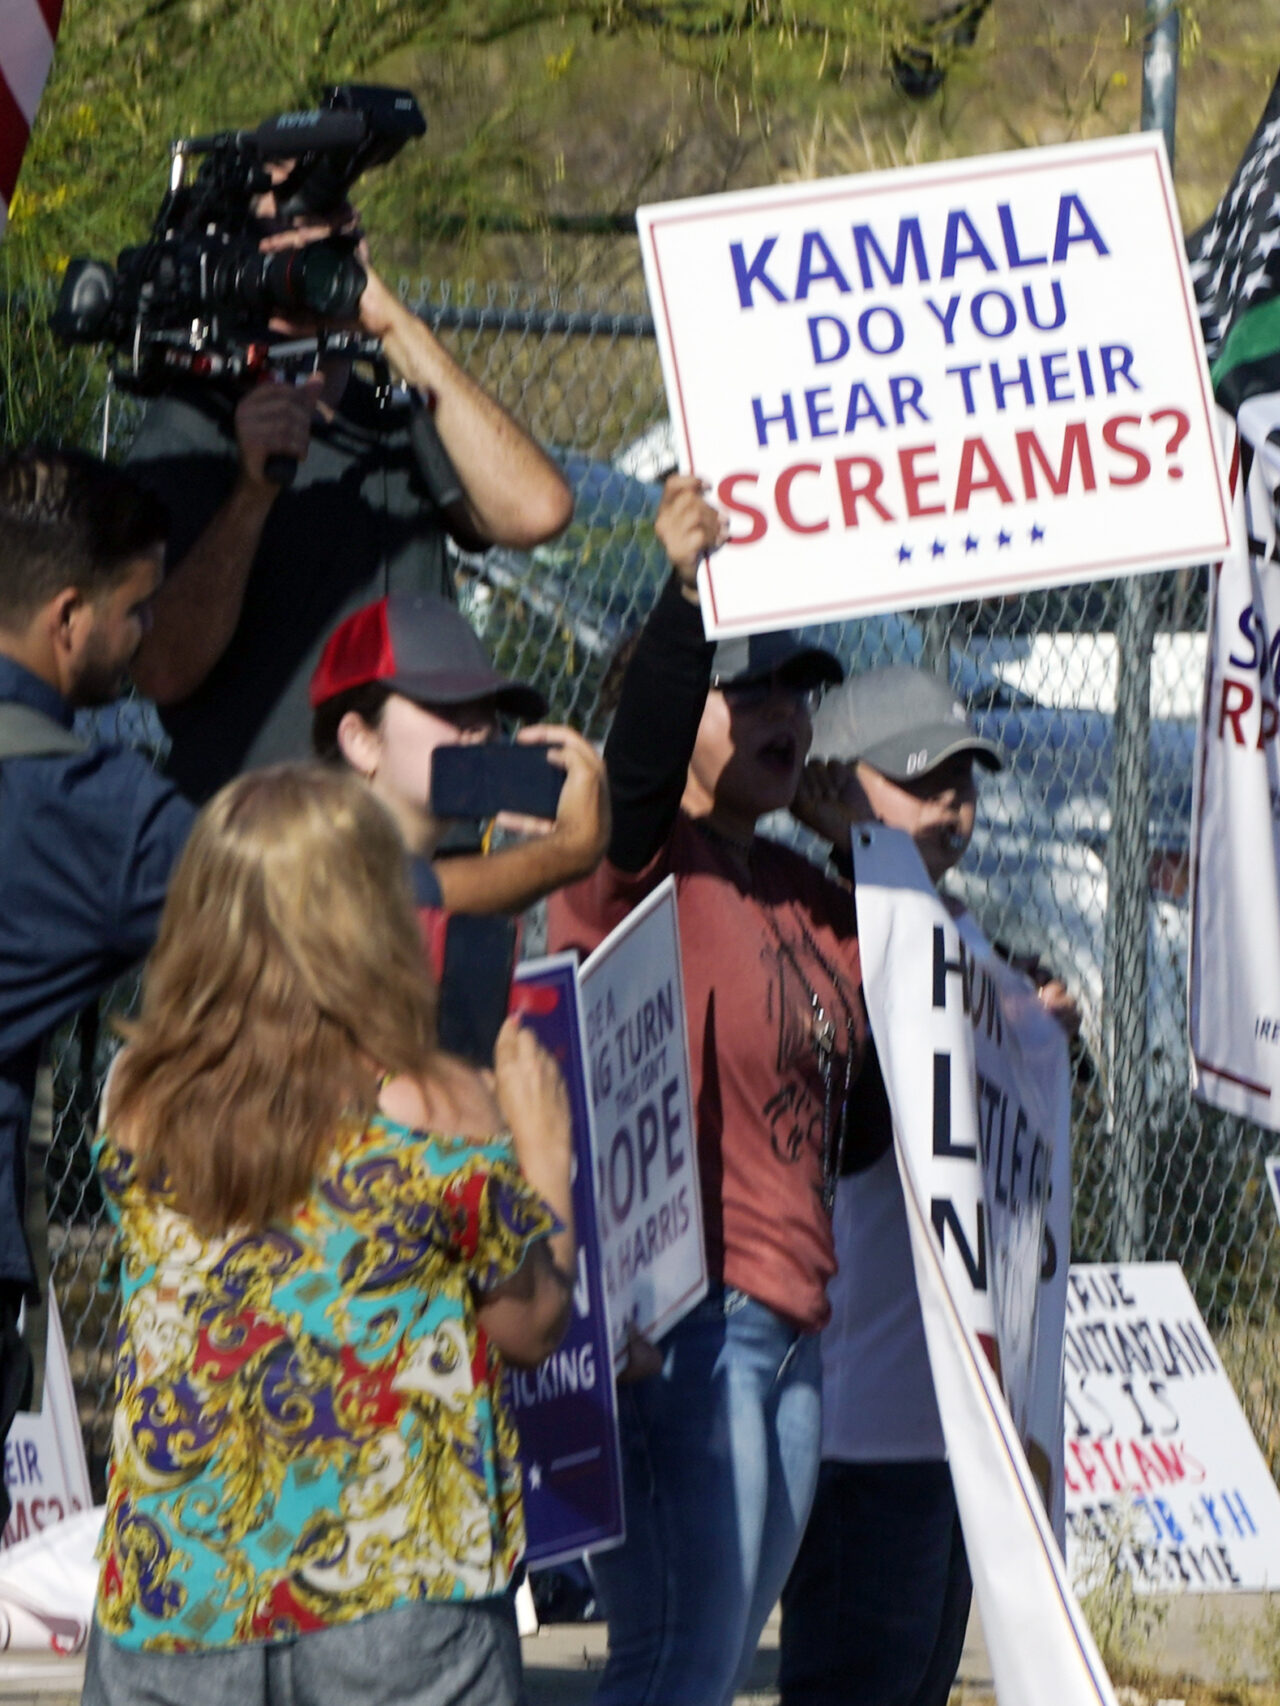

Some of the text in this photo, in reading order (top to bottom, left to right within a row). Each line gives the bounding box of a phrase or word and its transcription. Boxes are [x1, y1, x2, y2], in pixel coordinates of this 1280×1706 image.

[729, 193, 1110, 309] KAMALA
[807, 280, 1068, 365] DO YOU
[751, 343, 1142, 448] HEAR THEIR
[716, 409, 1191, 546] SCREAMS?
[615, 980, 674, 1079] TURN
[618, 1184, 690, 1292] HARRIS
[4, 1440, 43, 1486] EIR
